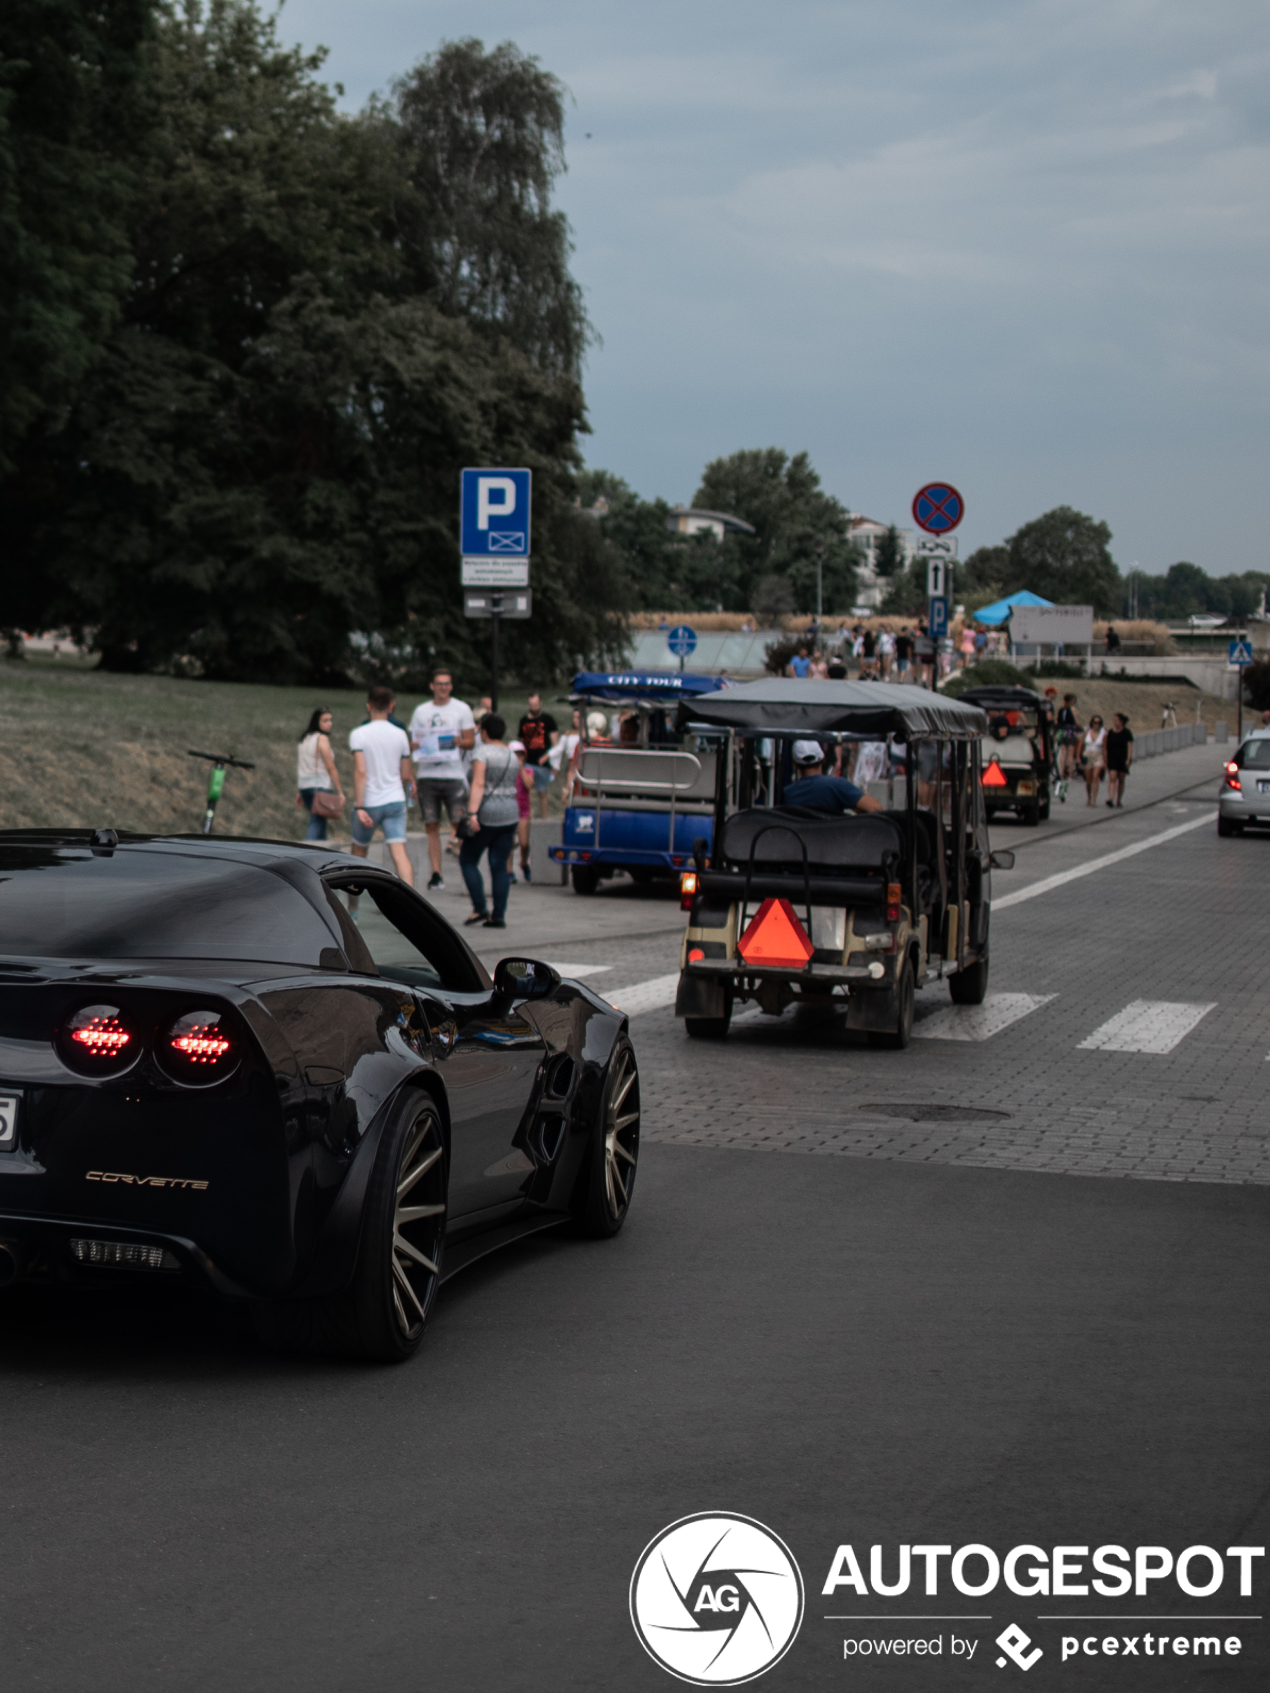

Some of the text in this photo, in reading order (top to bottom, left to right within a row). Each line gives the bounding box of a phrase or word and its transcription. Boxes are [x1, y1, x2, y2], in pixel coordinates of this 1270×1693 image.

[478, 477, 516, 530] P
[934, 601, 945, 631] P
[608, 675, 683, 688] CITY TOUR
[85, 1171, 209, 1190] CORVETTE
